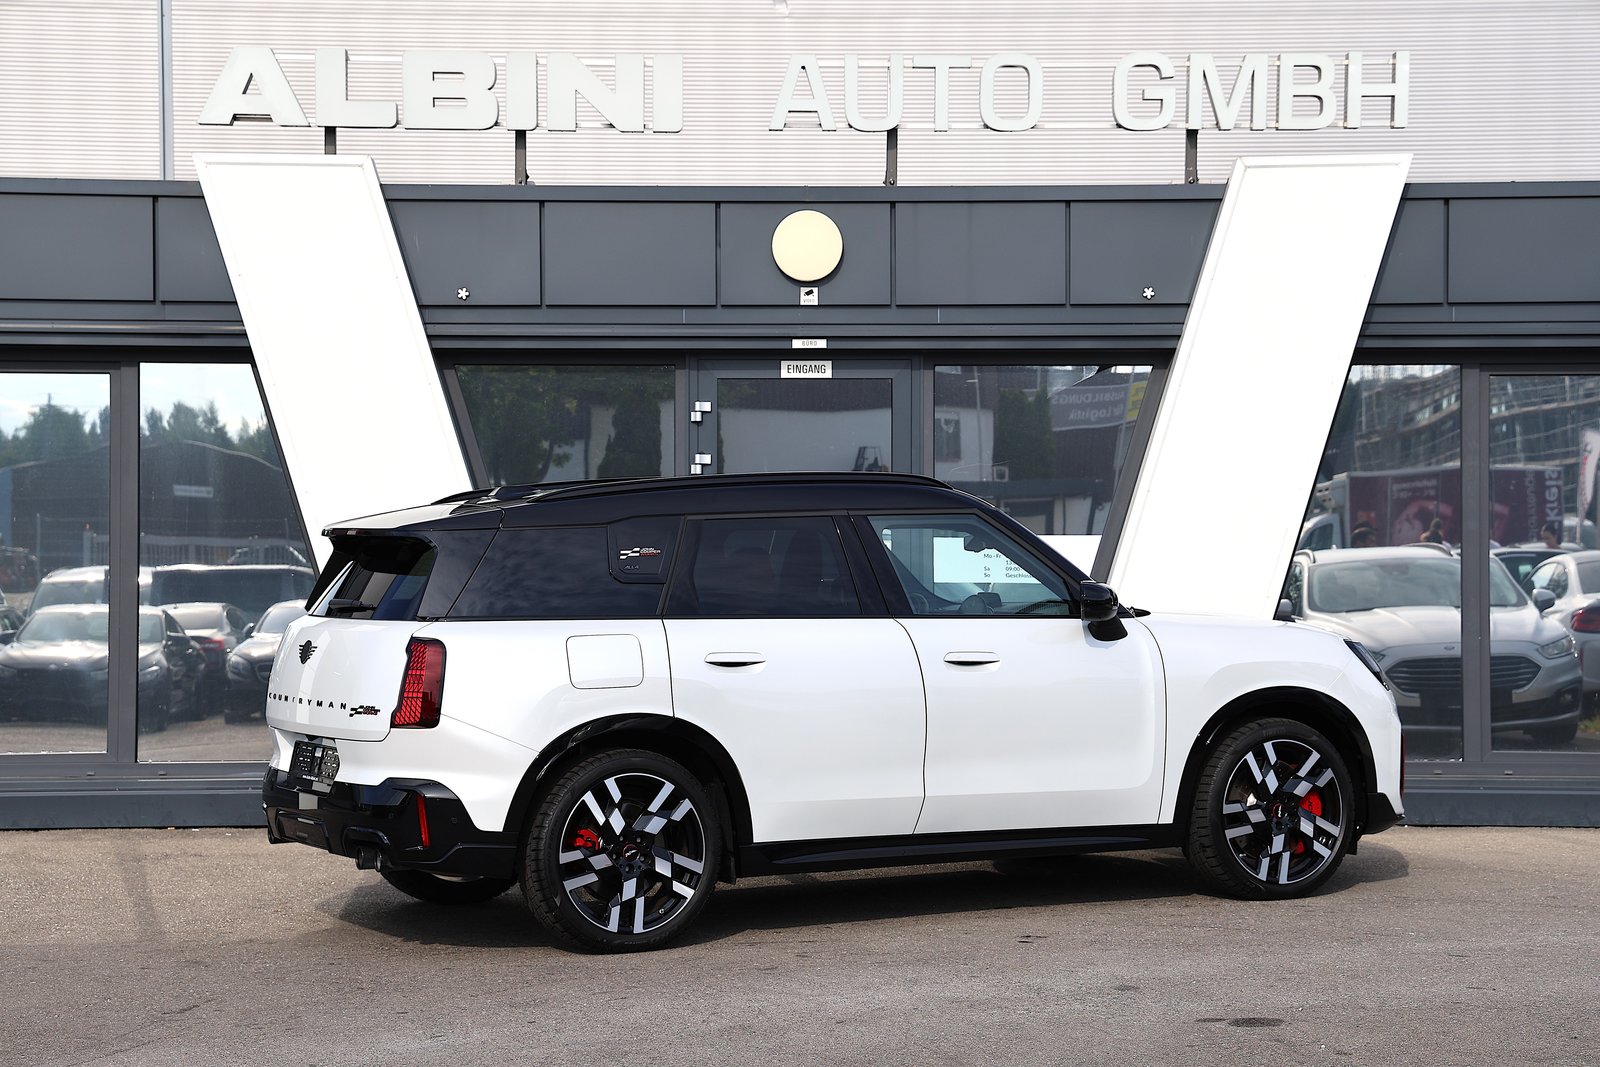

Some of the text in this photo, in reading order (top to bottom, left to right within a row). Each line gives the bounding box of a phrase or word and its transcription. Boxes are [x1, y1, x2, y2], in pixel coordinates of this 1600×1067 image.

[198, 46, 1411, 132] ALBINI AUTO GMBH
[787, 364, 827, 374] EINGANG
